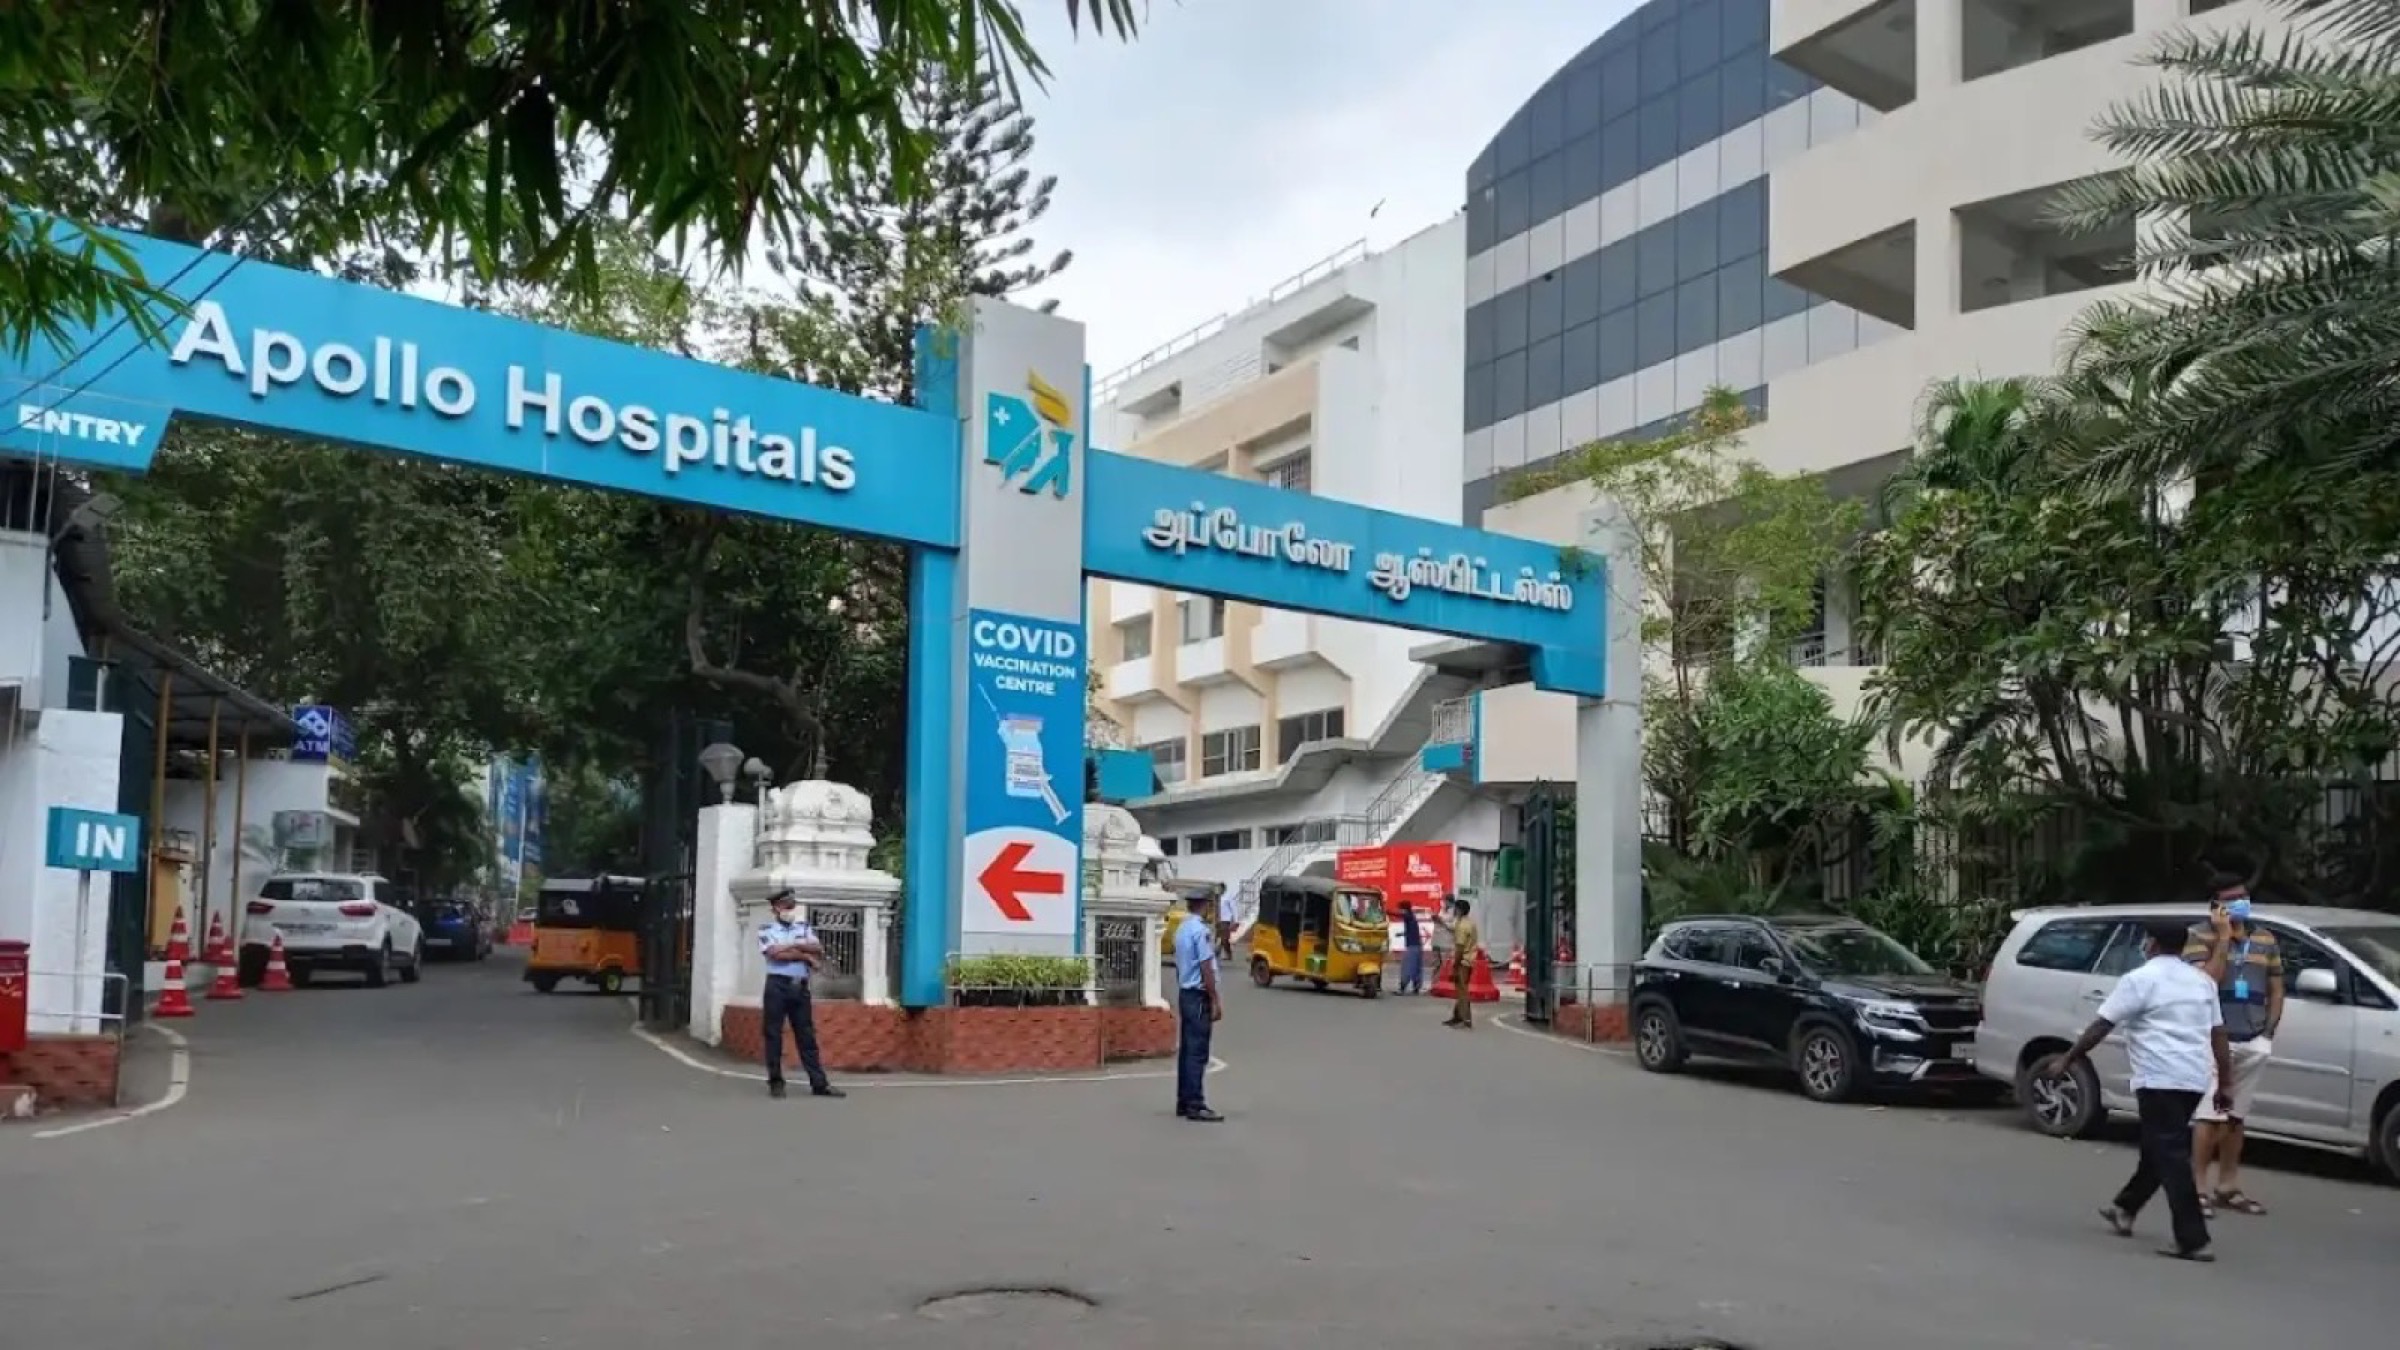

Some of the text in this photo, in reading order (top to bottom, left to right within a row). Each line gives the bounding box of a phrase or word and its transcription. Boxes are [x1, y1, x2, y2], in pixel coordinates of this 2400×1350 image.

[170, 300, 857, 491] Apollo Hospitals
[18, 404, 147, 447] ENTRY
[1143, 501, 1574, 611] அப்போலோ ஆஸ்பிட்டல்ஸ்
[974, 620, 1076, 659] COVID
[974, 652, 1076, 680] VACCINATION
[996, 676, 1055, 695] CENTRE
[294, 740, 329, 753] ATM
[76, 821, 127, 860] IN
